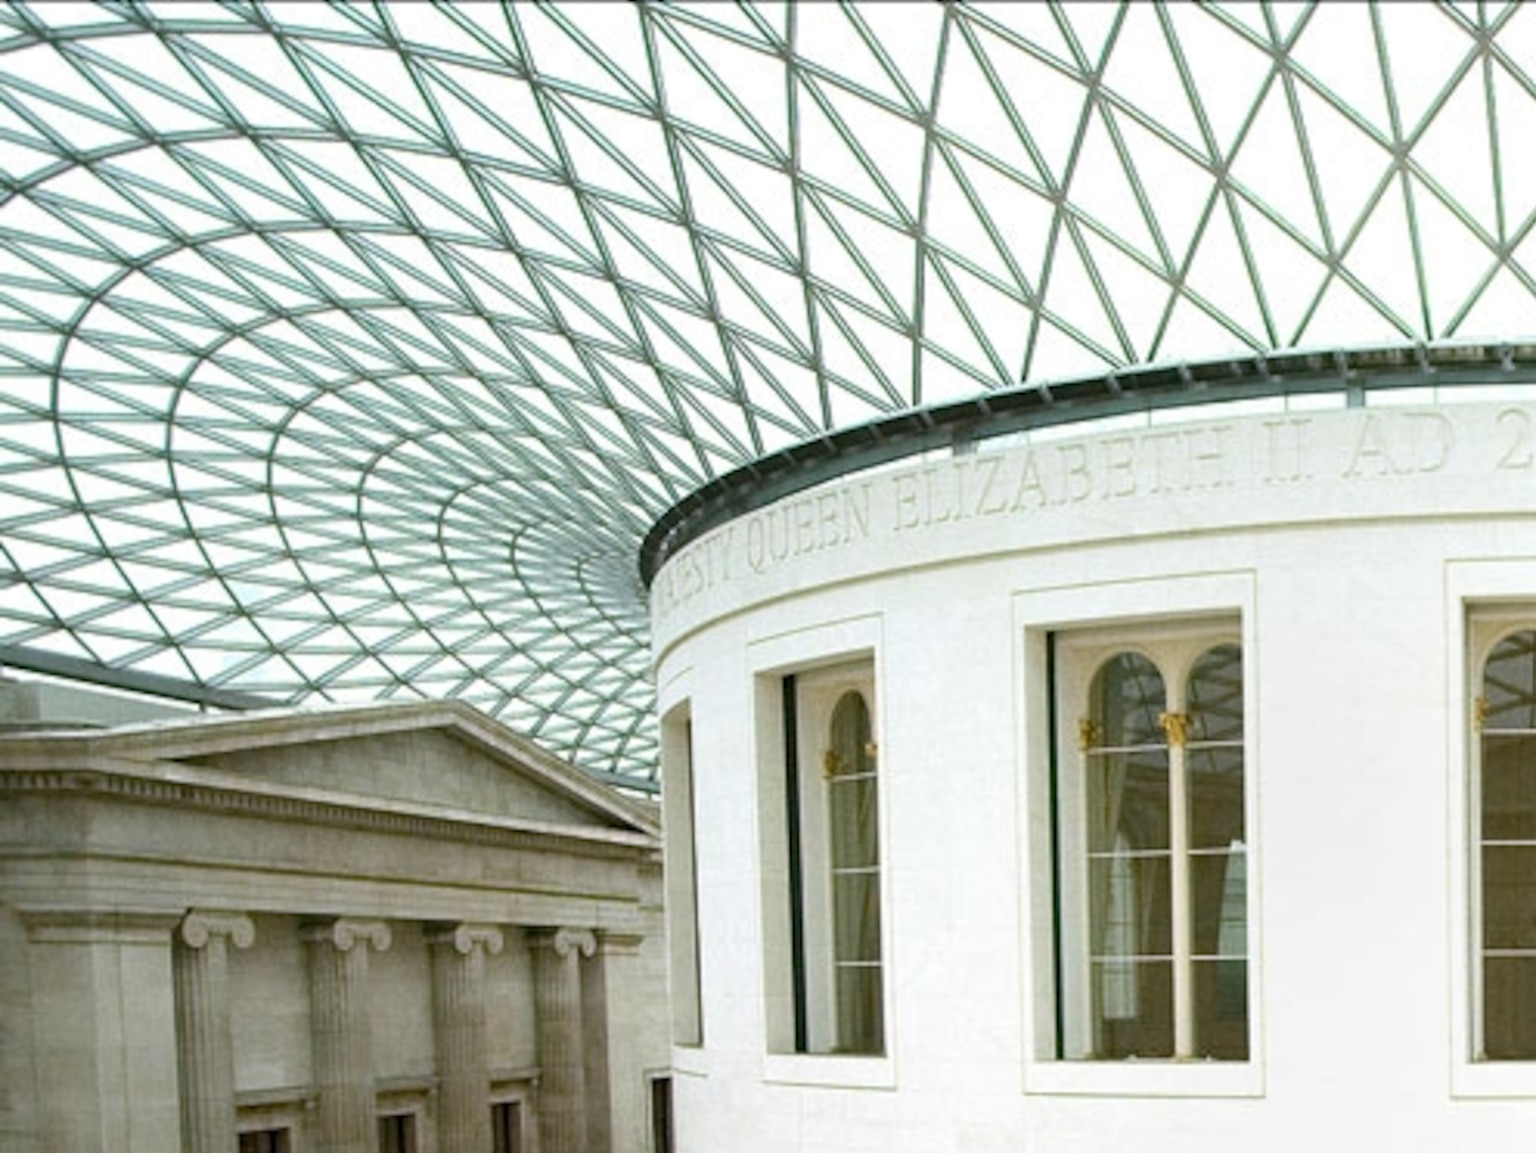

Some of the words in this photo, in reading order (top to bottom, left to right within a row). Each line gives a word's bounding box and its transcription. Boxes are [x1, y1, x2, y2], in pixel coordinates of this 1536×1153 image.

[747, 482, 873, 574] QUEEN
[892, 424, 1235, 532] ELIZABETH
[1263, 419, 1313, 482] II
[1342, 411, 1455, 479] AD
